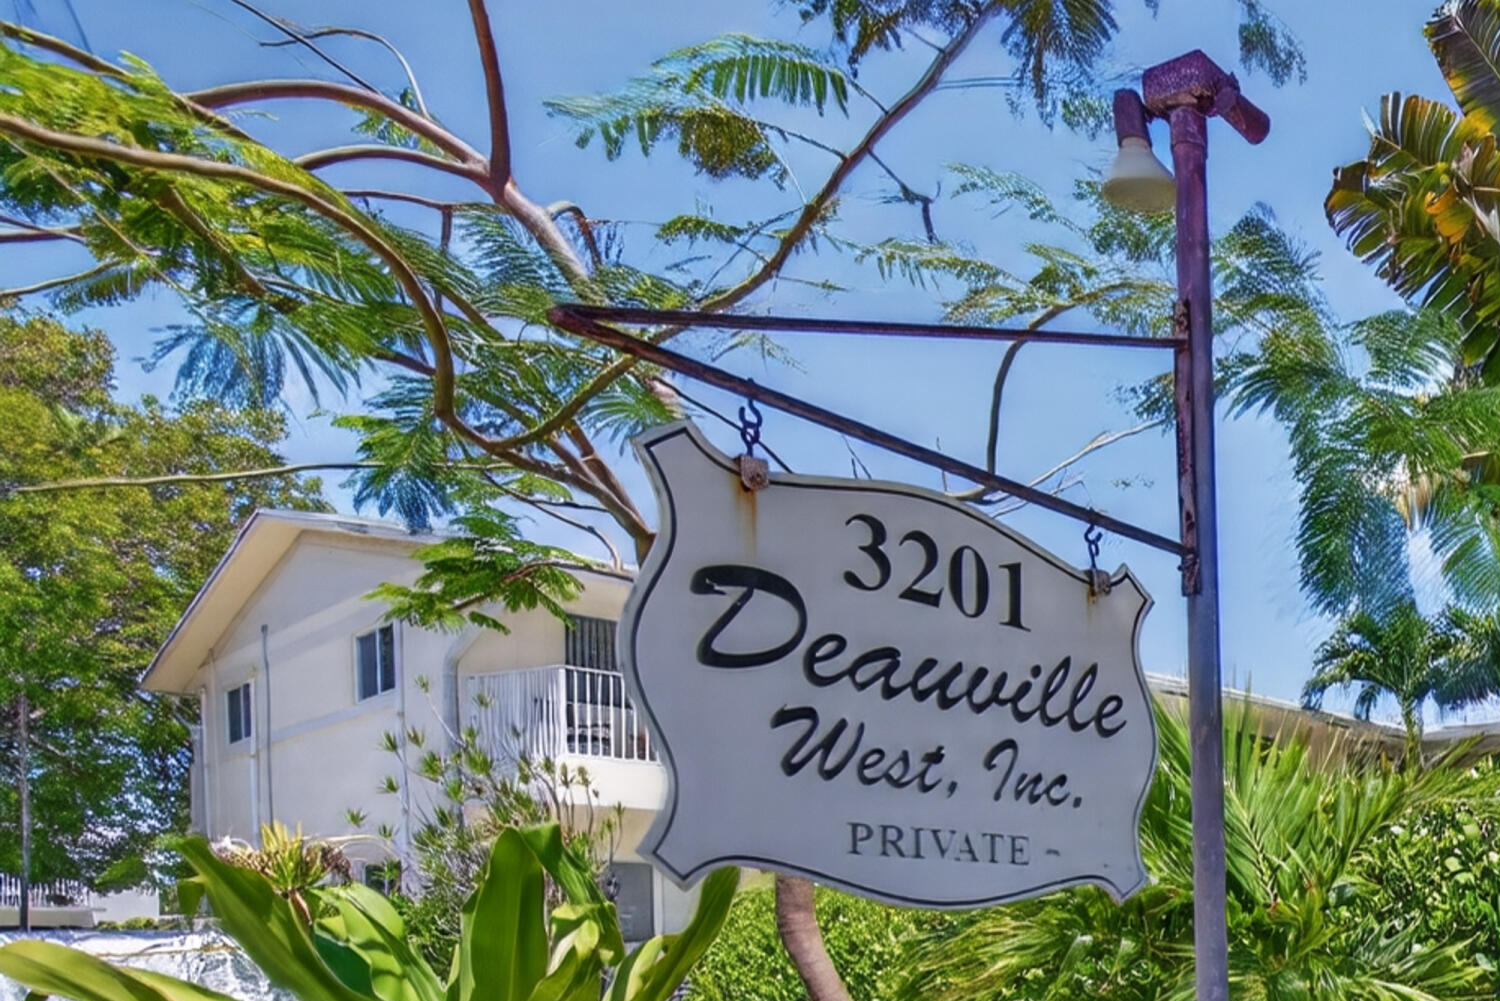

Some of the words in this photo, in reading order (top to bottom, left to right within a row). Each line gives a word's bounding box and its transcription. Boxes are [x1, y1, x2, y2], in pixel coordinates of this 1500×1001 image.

[843, 513, 1032, 633] 3201
[689, 564, 1128, 739] Deauville
[770, 704, 958, 798] West,
[983, 738, 1083, 809] Inc.
[846, 821, 1030, 866] PRIVATE
